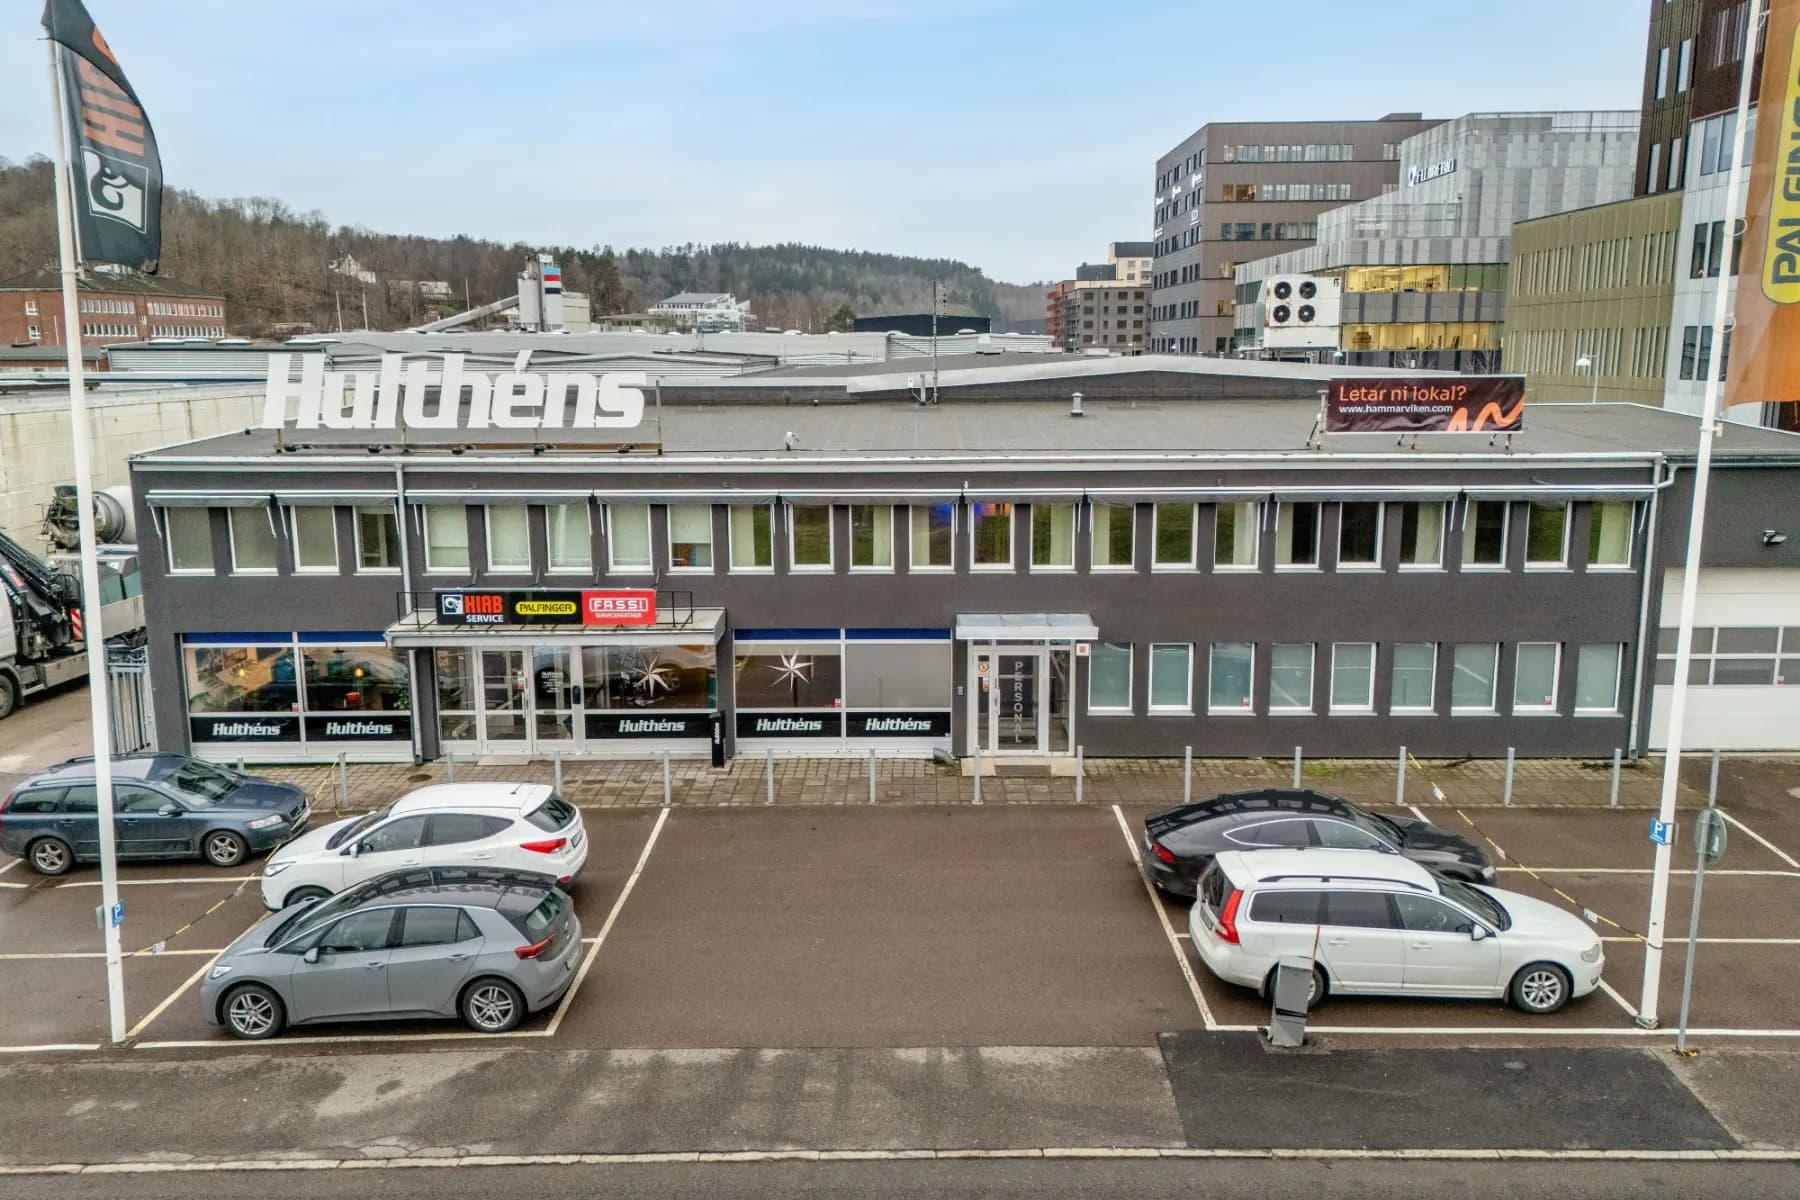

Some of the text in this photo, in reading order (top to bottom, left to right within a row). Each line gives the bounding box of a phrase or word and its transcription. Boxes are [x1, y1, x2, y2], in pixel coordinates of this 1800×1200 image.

[262, 349, 647, 430] Hulthéns
[1340, 385, 1467, 402] Letar ni lokal?
[1339, 404, 1453, 414] www.hammarviken.com
[464, 595, 503, 613] HIAB
[519, 603, 573, 612] PALFINGER
[593, 600, 643, 610] FASSI
[466, 614, 504, 623] SERVICE
[1013, 661, 1024, 743] PERSONAL
[212, 722, 281, 737] Hulthéns
[326, 721, 393, 736] Hulthéns
[618, 718, 686, 733] Hulthéns
[756, 717, 823, 732] Hulthéns
[865, 717, 932, 731] Hulthéns
[1655, 820, 1664, 834] P
